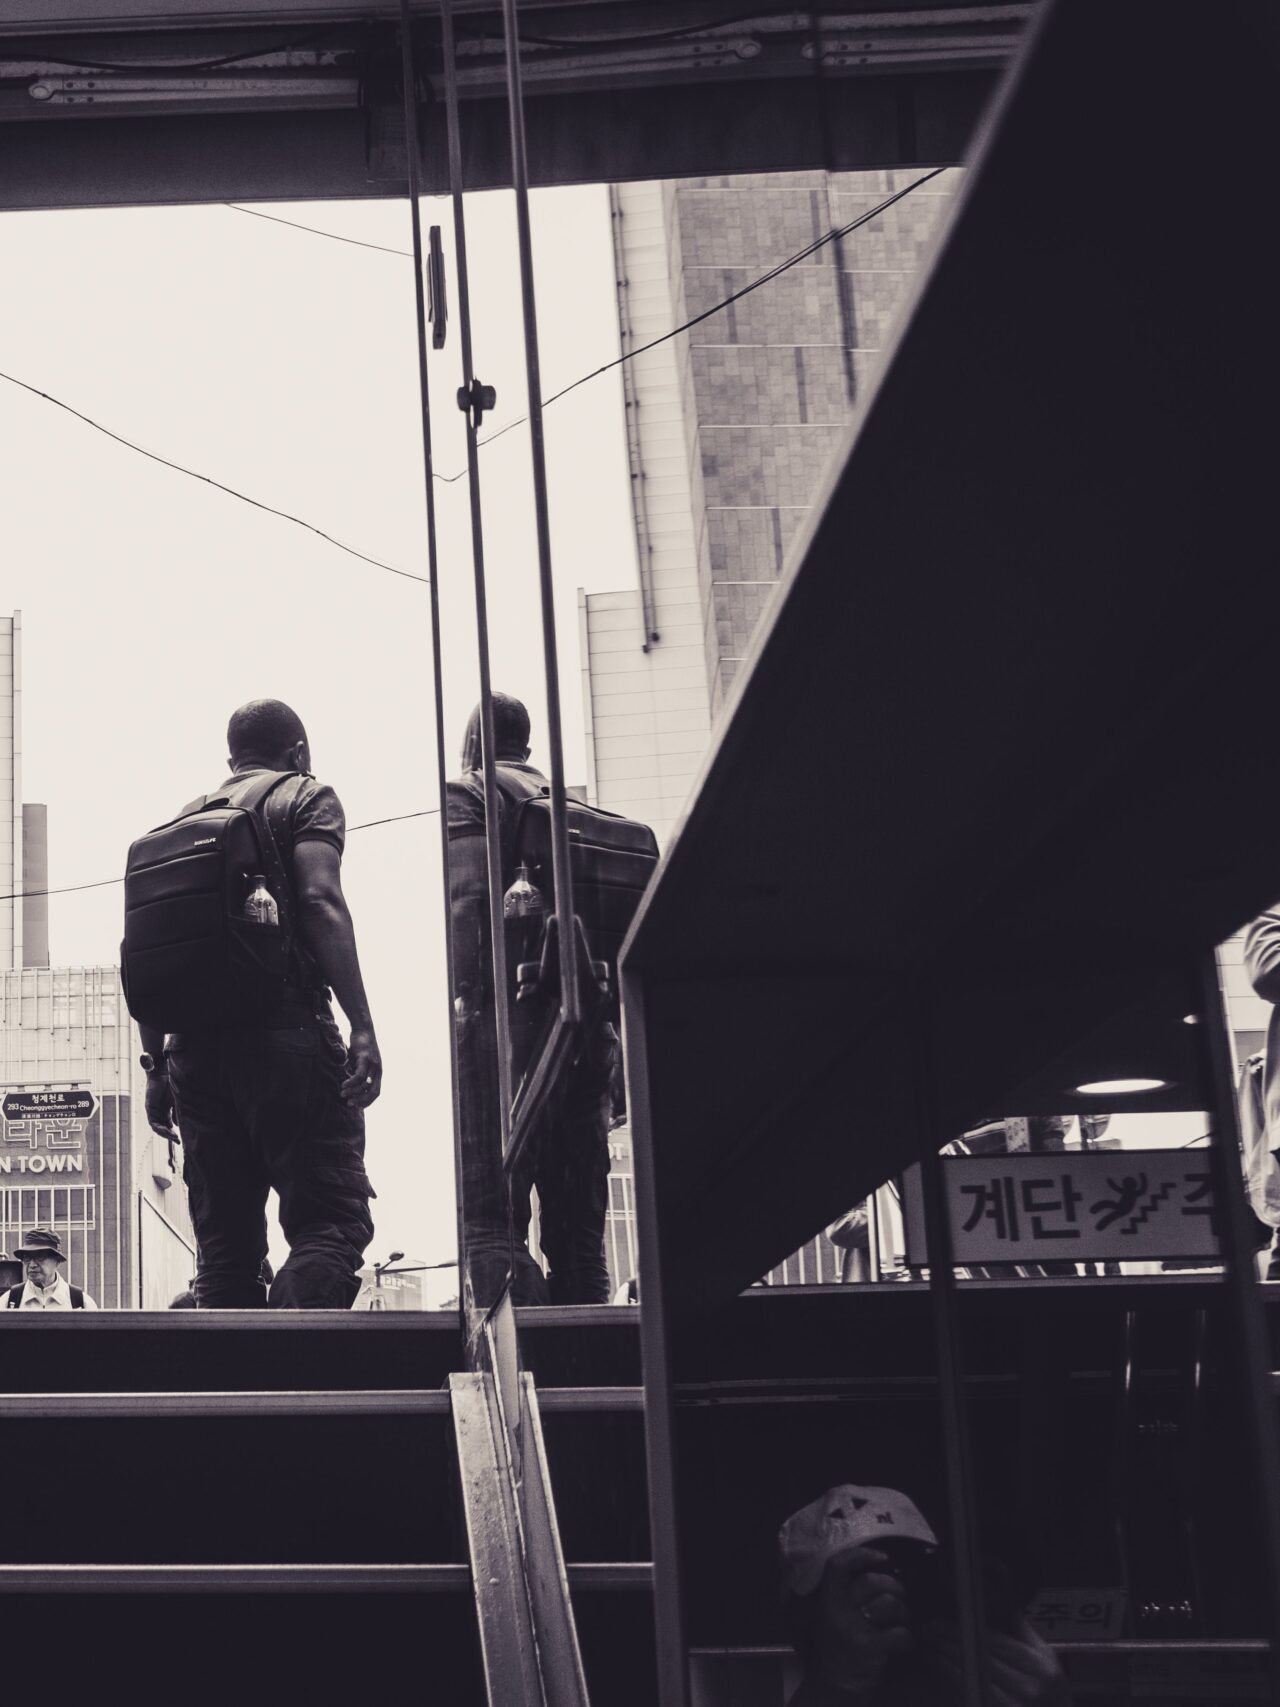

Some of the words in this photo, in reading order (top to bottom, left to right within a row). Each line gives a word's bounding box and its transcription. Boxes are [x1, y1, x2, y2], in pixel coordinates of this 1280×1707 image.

[7, 1103, 19, 1111] 293
[77, 1100, 89, 1108] 289
[18, 1155, 82, 1173] TOWN
[960, 1174, 1083, 1241] 계단
[1032, 1601, 1112, 1630] 주의
